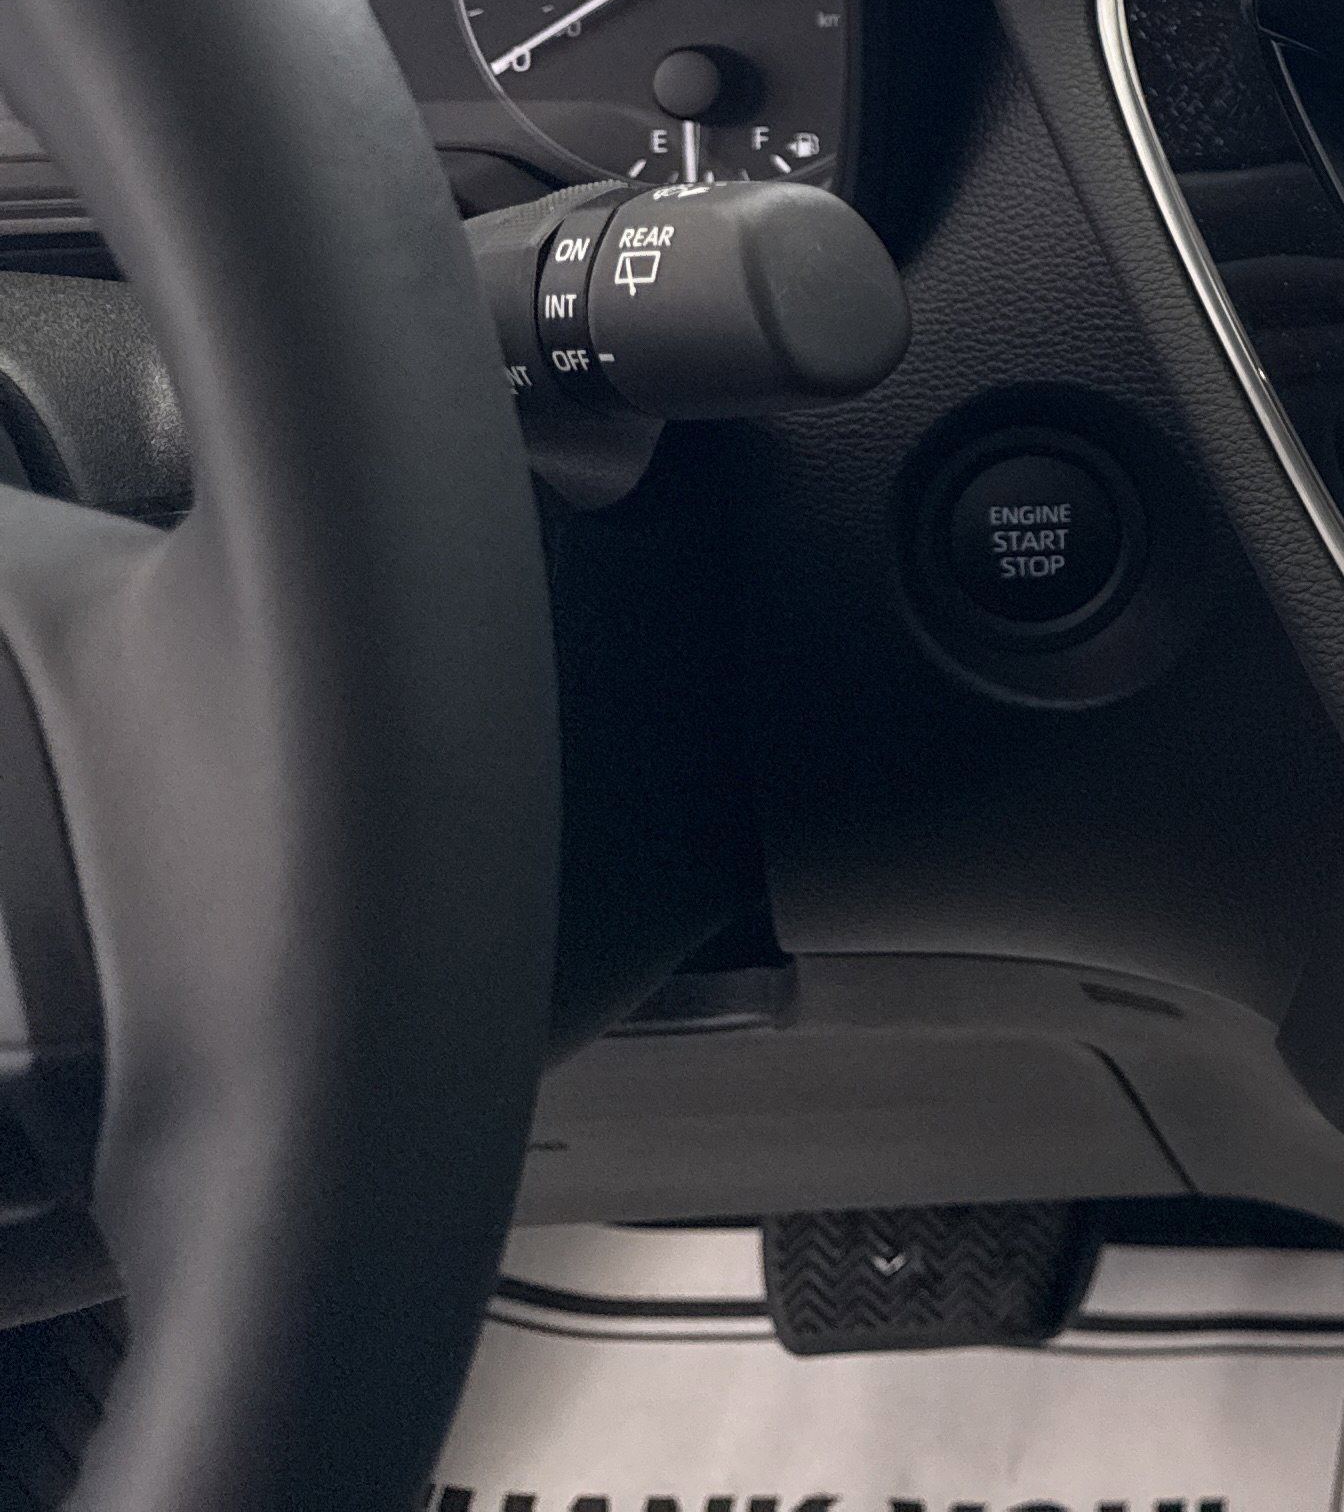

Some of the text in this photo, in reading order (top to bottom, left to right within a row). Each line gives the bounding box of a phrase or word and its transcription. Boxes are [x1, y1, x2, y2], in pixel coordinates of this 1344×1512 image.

[652, 129, 669, 154] E
[751, 125, 770, 151] F
[618, 225, 675, 249] REAR
[554, 237, 591, 263] ON
[544, 293, 578, 319] INT
[551, 349, 590, 372] OFF
[506, 365, 533, 387] NT
[989, 503, 1072, 526] ENGINE
[992, 528, 1070, 553] START
[999, 554, 1066, 579] STOP
